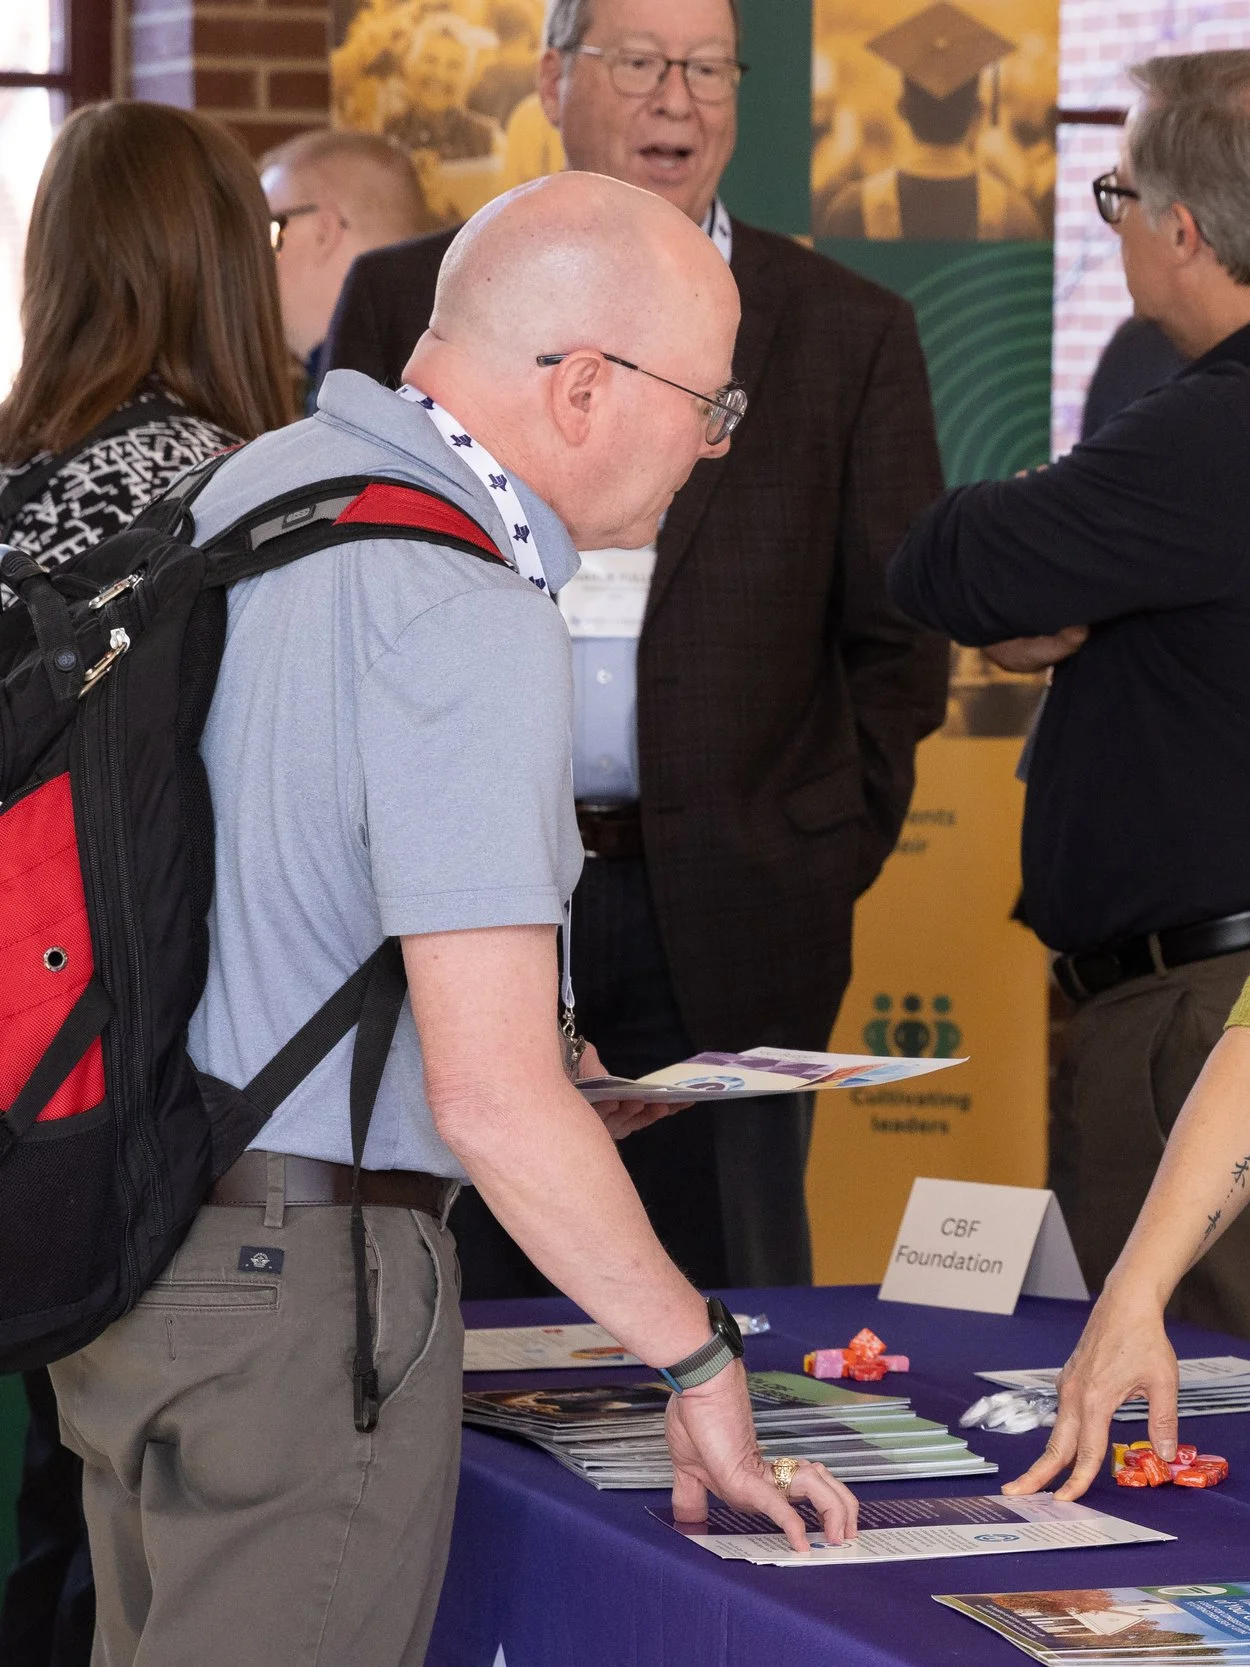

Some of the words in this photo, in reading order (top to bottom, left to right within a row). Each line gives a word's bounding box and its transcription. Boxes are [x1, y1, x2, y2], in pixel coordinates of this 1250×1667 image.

[849, 1086, 971, 1112] Cultivating
[870, 1115, 949, 1133] leaders
[941, 1217, 982, 1238] CBF
[895, 1244, 1004, 1275] Foundation
